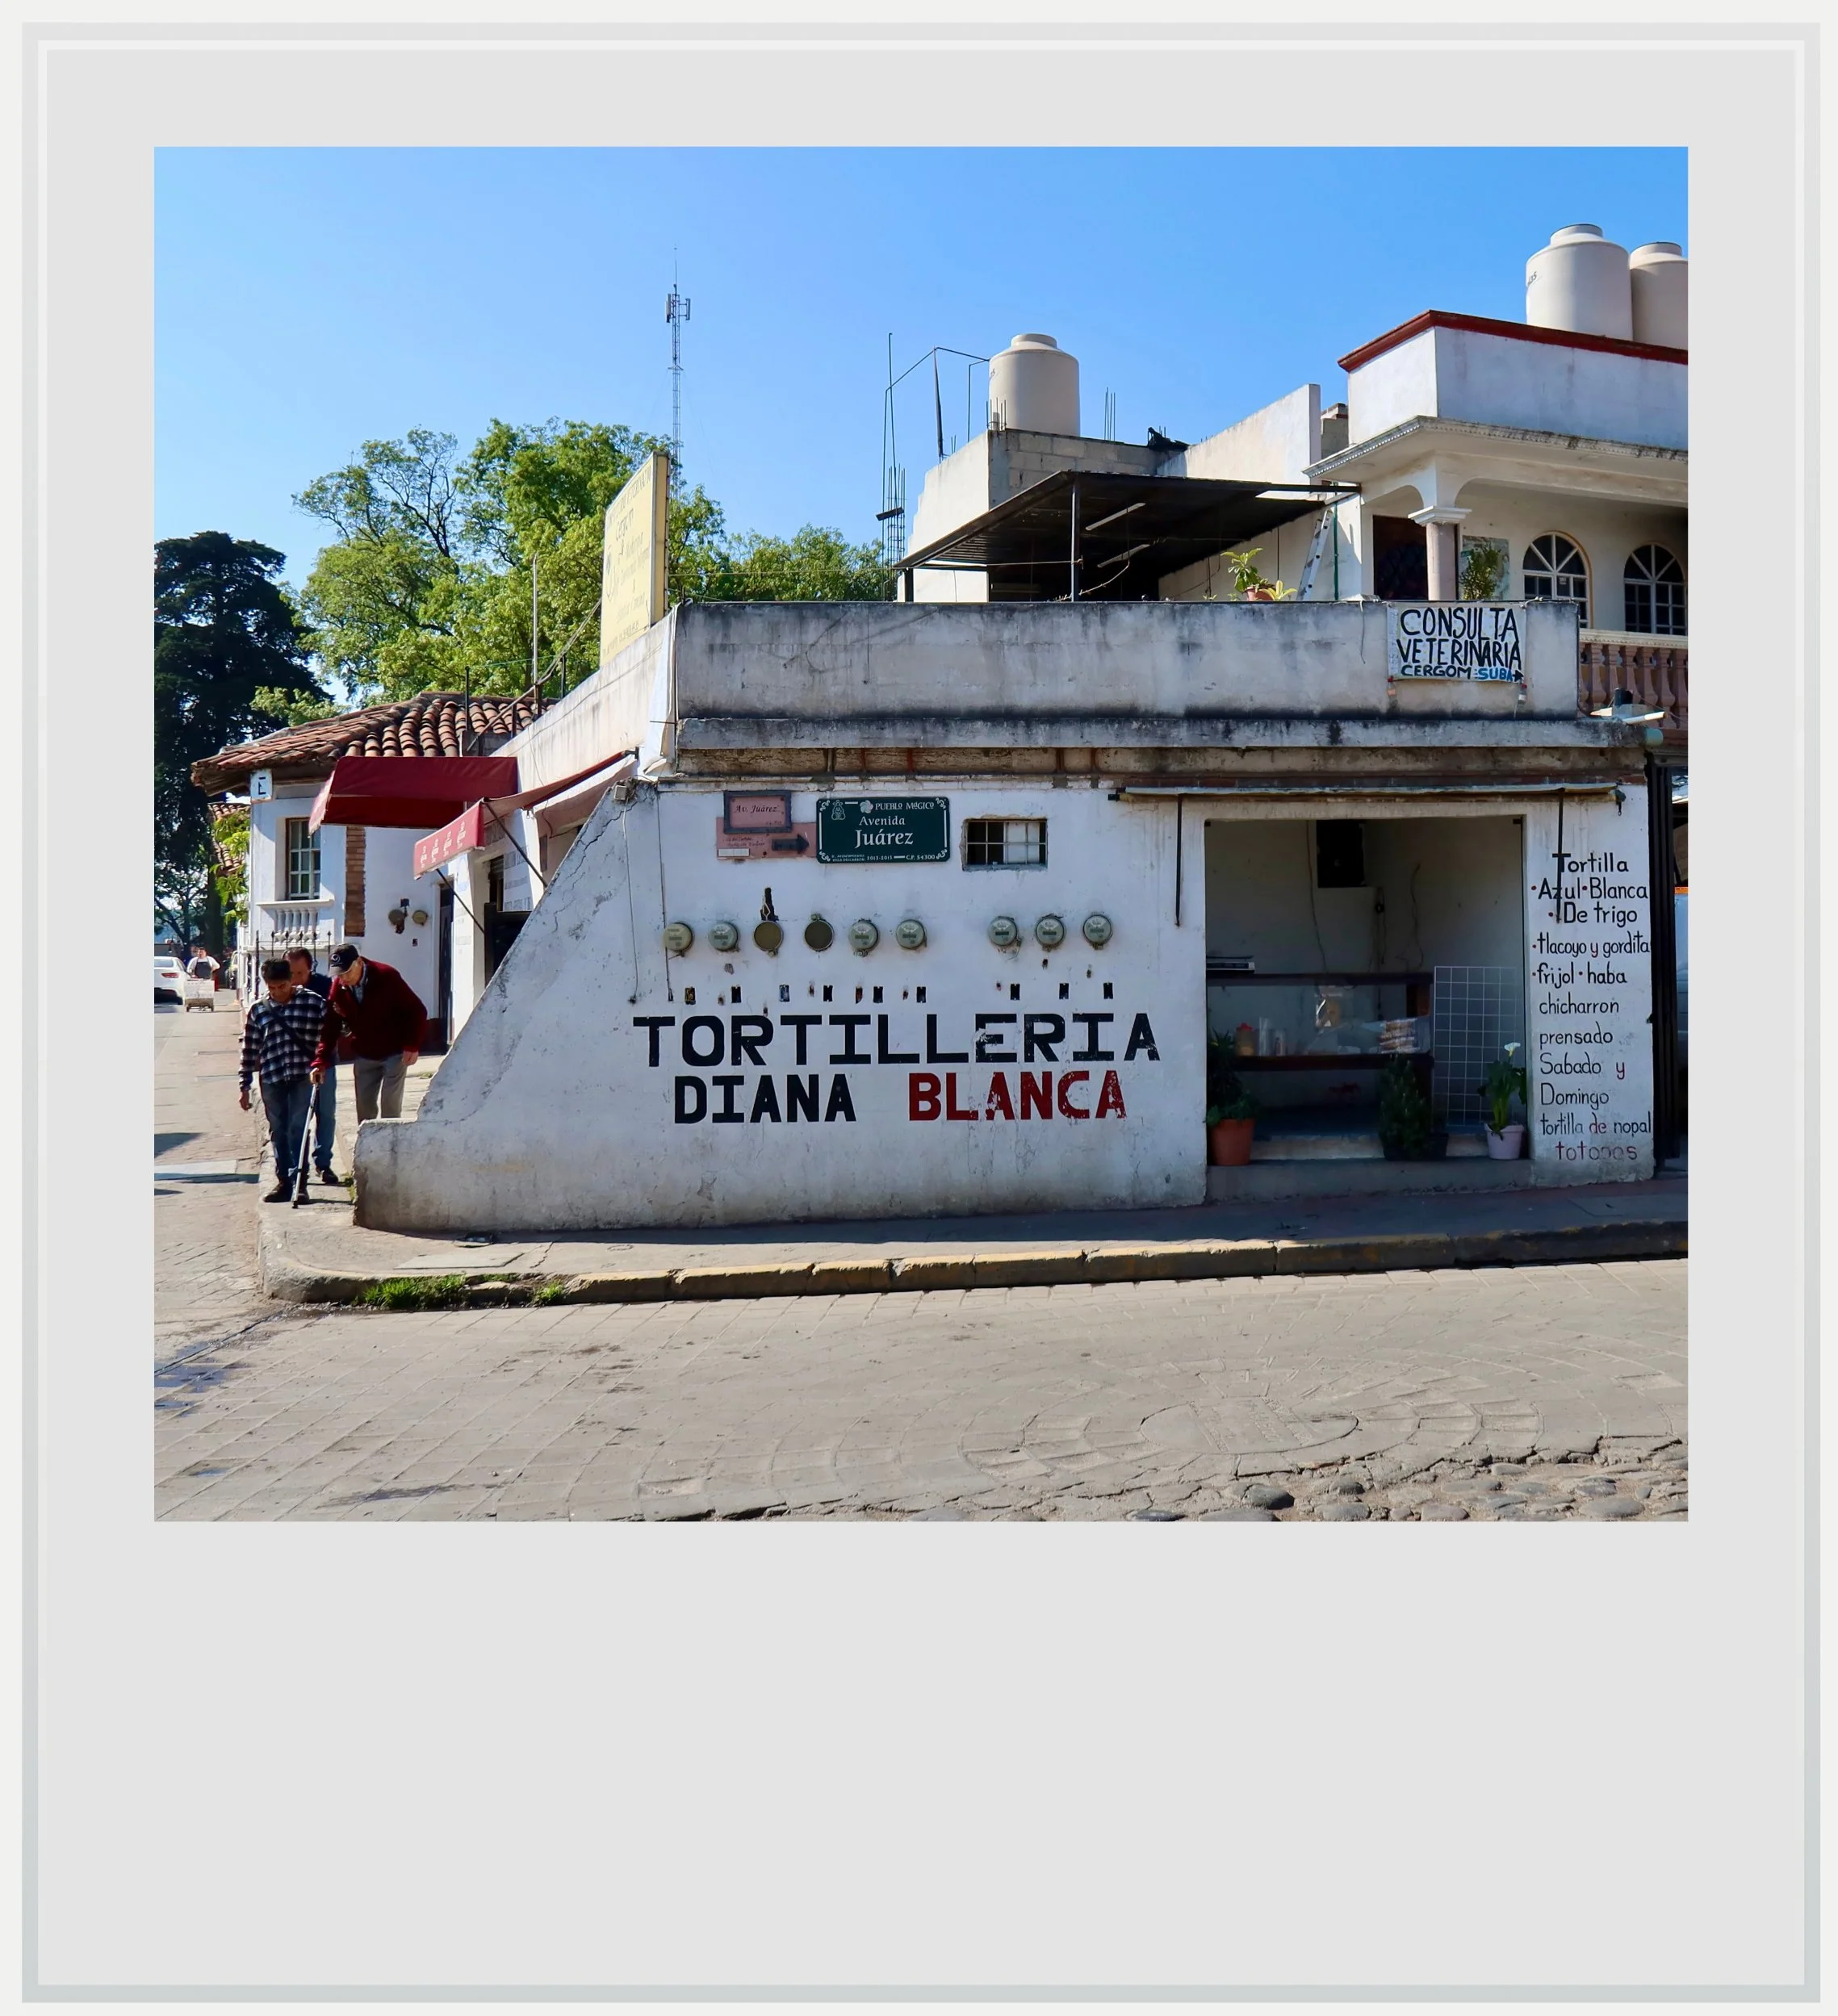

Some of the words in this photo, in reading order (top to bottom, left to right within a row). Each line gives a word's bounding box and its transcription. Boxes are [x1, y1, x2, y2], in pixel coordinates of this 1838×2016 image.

[1400, 607, 1519, 642] CONSULTA
[1396, 638, 1522, 670] VETERINARIA
[1400, 664, 1472, 680] CERGOM
[1478, 667, 1513, 681] SUBA
[733, 805, 748, 814] Av.
[750, 804, 778, 814] Juárez
[875, 802, 903, 810] PUEBLO
[859, 816, 906, 826] Avenida
[855, 829, 914, 848] Juárez
[1552, 852, 1629, 873] Tortilla
[1538, 876, 1581, 900] Azul
[1589, 876, 1648, 899] Blanca
[1564, 901, 1588, 924] De
[1593, 901, 1638, 928] trigo
[1537, 931, 1587, 958] tlacoyo
[1590, 942, 1598, 958] y
[1602, 931, 1650, 958] gordita
[1537, 961, 1574, 989] frijol
[1587, 961, 1627, 984] haba
[1539, 992, 1619, 1014] chicharron
[633, 1013, 1160, 1068] TORTILLERIA
[1539, 1021, 1613, 1050] prensado
[1539, 1052, 1601, 1075] Sabado
[1616, 1061, 1625, 1080] y
[674, 1074, 857, 1124] DIANA
[908, 1070, 1128, 1123] BLANCA
[1540, 1082, 1610, 1110] Domingo
[1540, 1112, 1585, 1136] tortilla
[1589, 1111, 1606, 1134] de
[1614, 1110, 1651, 1137] nopal
